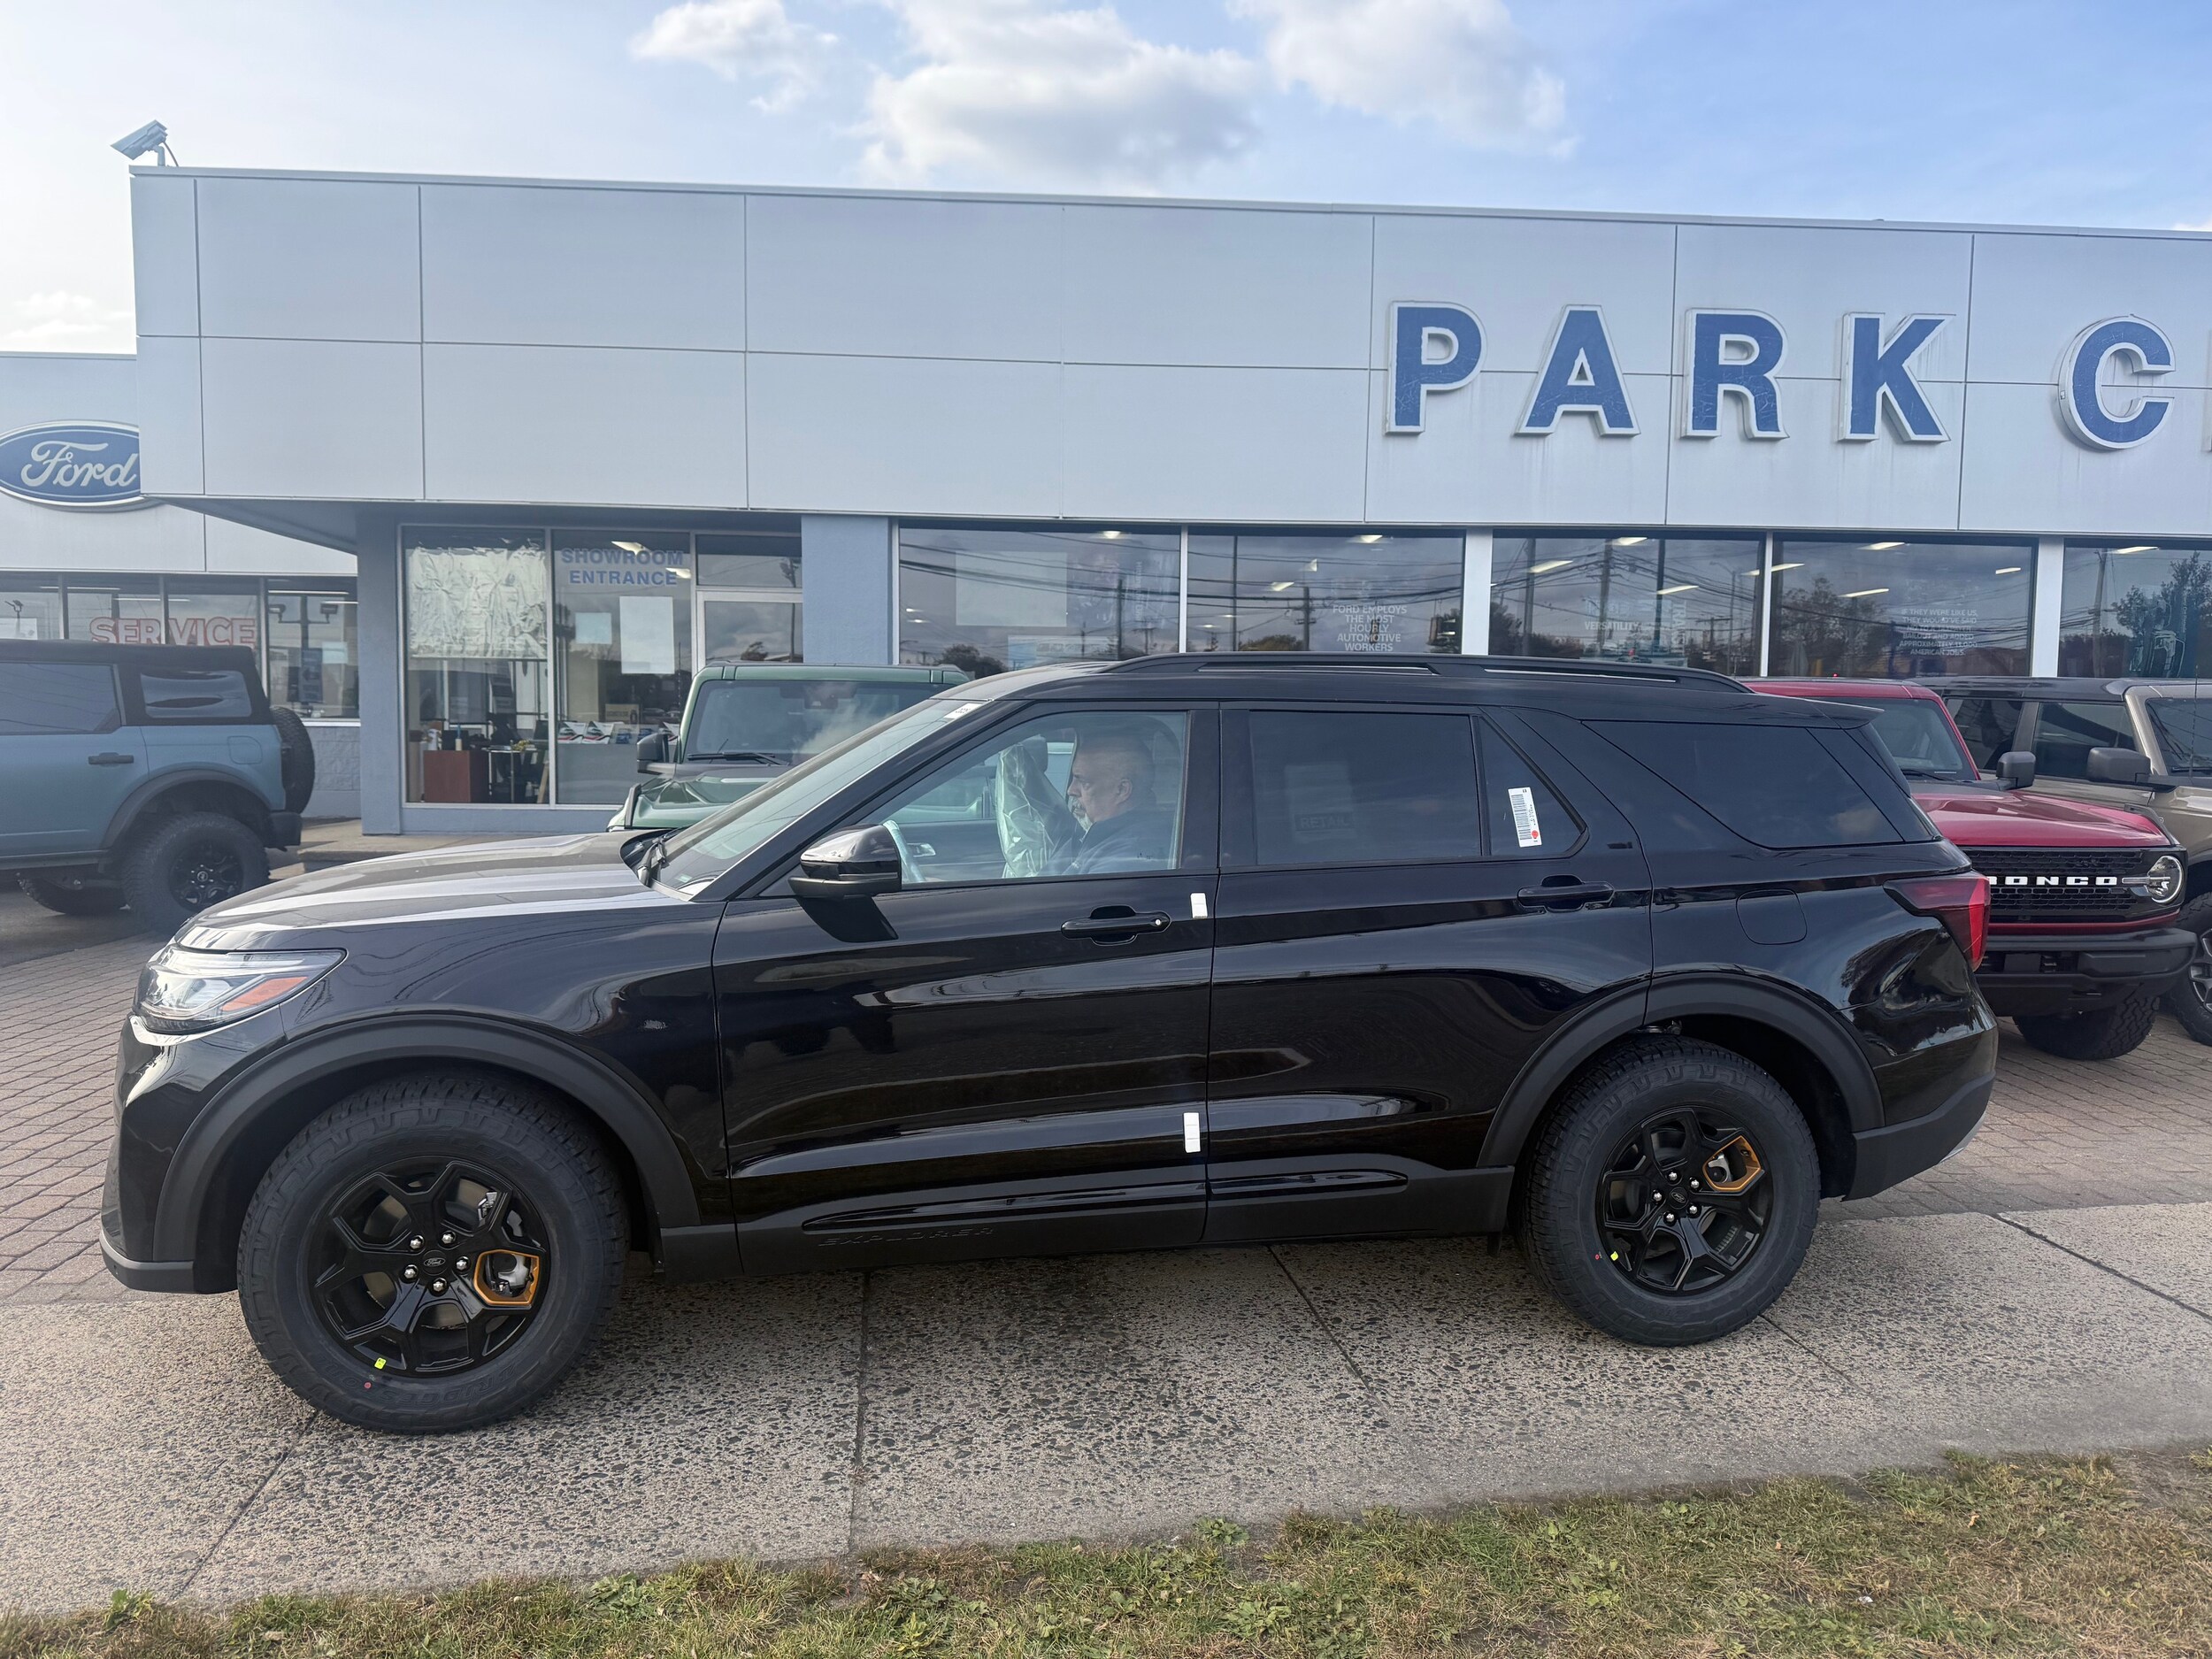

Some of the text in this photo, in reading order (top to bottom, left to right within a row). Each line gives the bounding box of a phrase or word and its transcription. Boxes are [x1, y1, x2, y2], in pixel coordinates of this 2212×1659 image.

[1384, 300, 2212, 452] PARK C
[20, 440, 139, 488] Ford
[561, 547, 684, 565] SHOWROOM
[569, 569, 678, 586] ENTRANCE
[1333, 605, 1408, 614] FORD EMPLOYS
[1345, 614, 1395, 624] THE MOST
[89, 617, 257, 649] SERVICE
[1349, 624, 1389, 634] HOURLY
[1337, 633, 1402, 642] AUTOMOTIVE
[1345, 642, 1394, 652] WORKERS
[1986, 875, 2118, 886] ONCO
